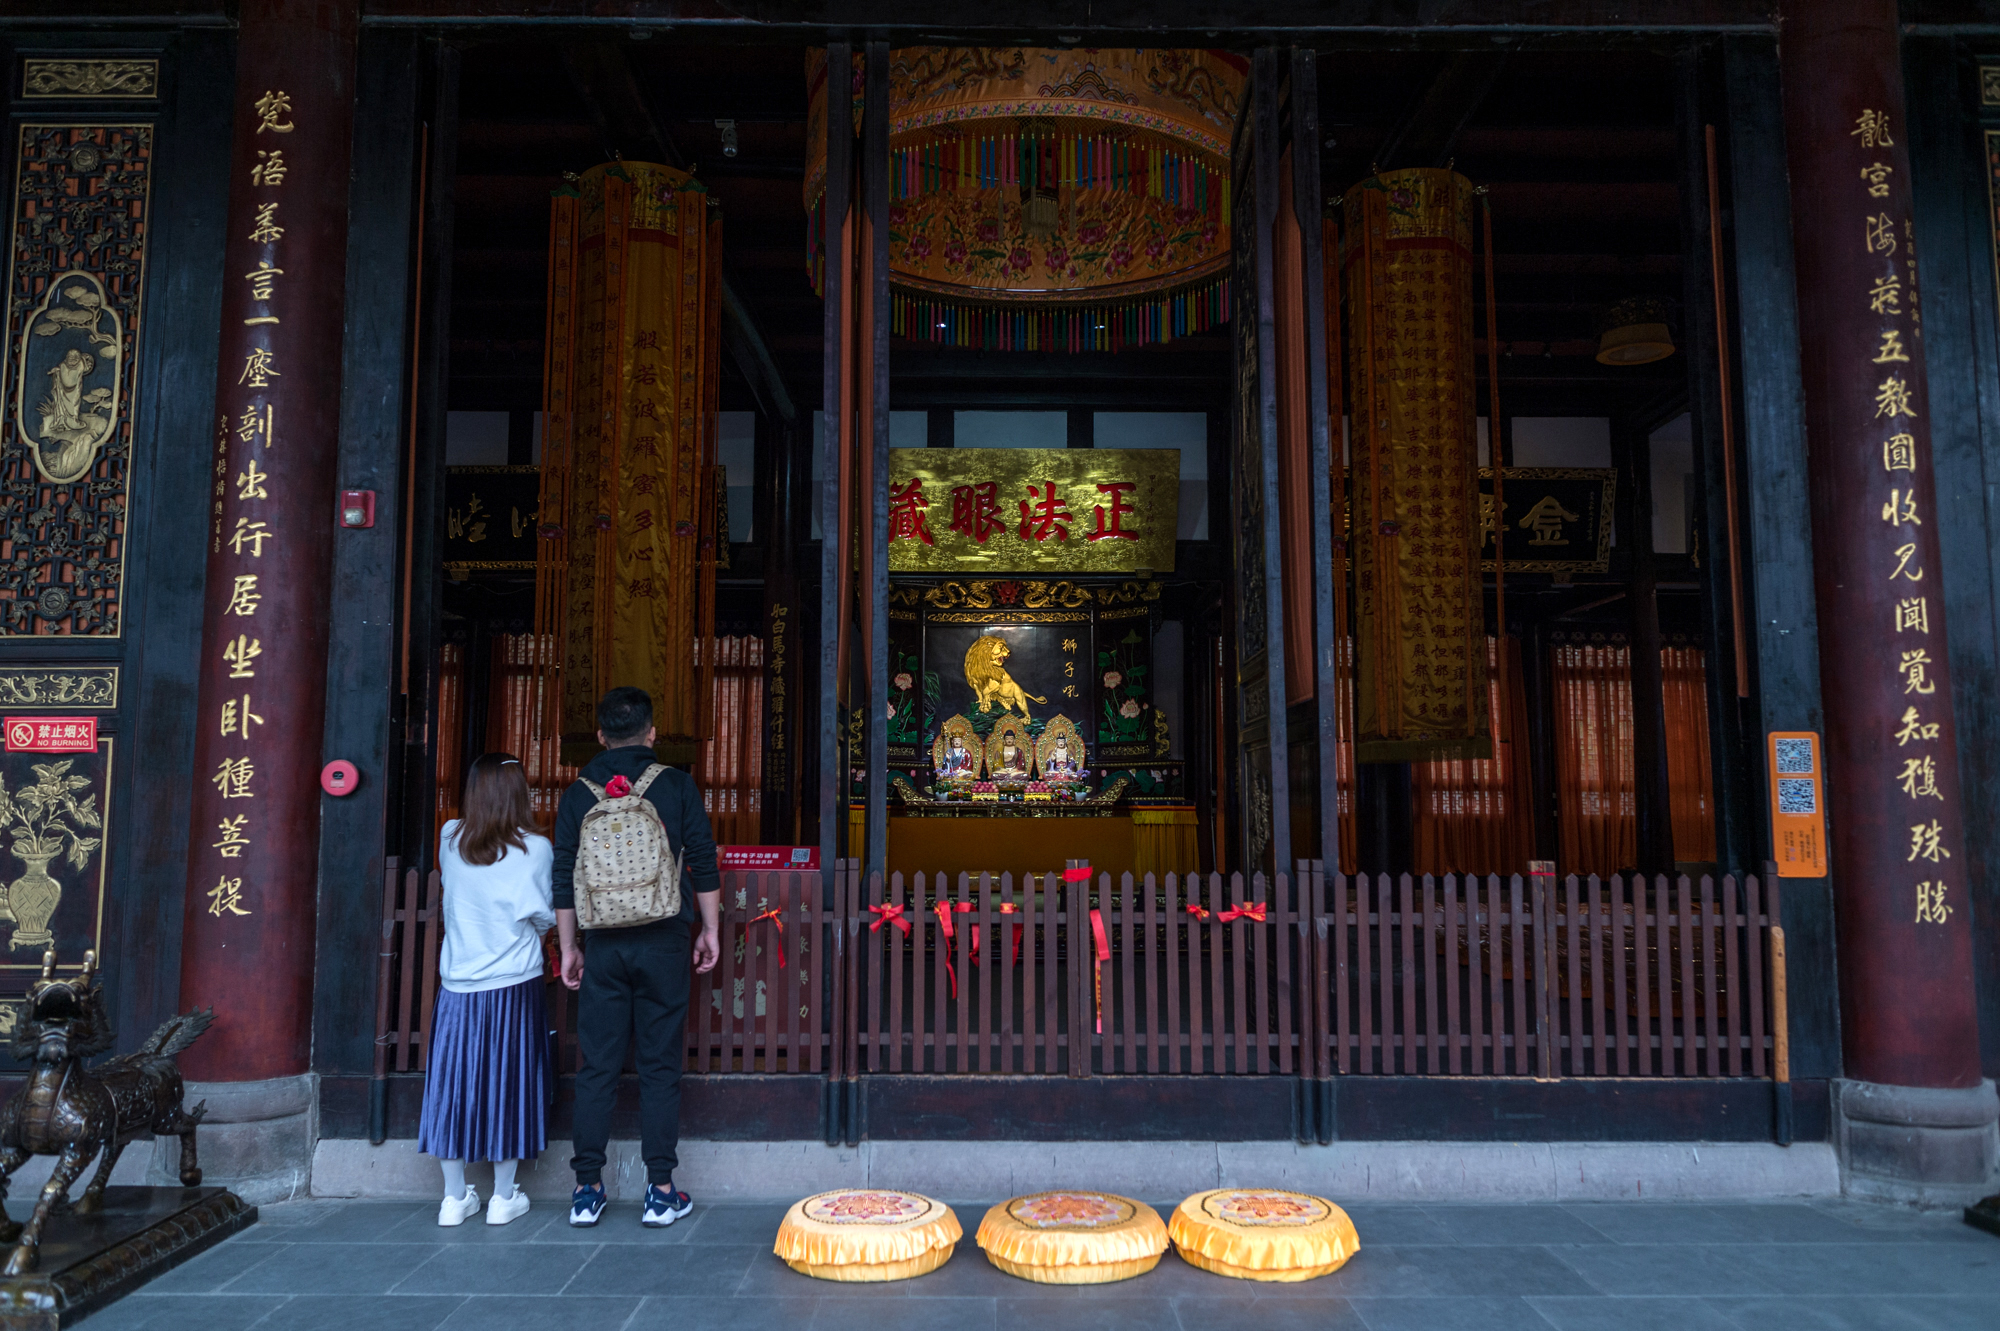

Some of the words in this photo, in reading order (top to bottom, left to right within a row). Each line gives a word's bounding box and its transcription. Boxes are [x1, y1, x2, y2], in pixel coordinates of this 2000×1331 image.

[629, 331, 661, 599] 般若波羅蜜多心經
[889, 478, 1139, 546] 正法眼藏
[1061, 638, 1079, 698] 獅子吼
[37, 739, 49, 747] NO
[52, 739, 89, 747] BURNING
[38, 724, 89, 739] 禁止烟火
